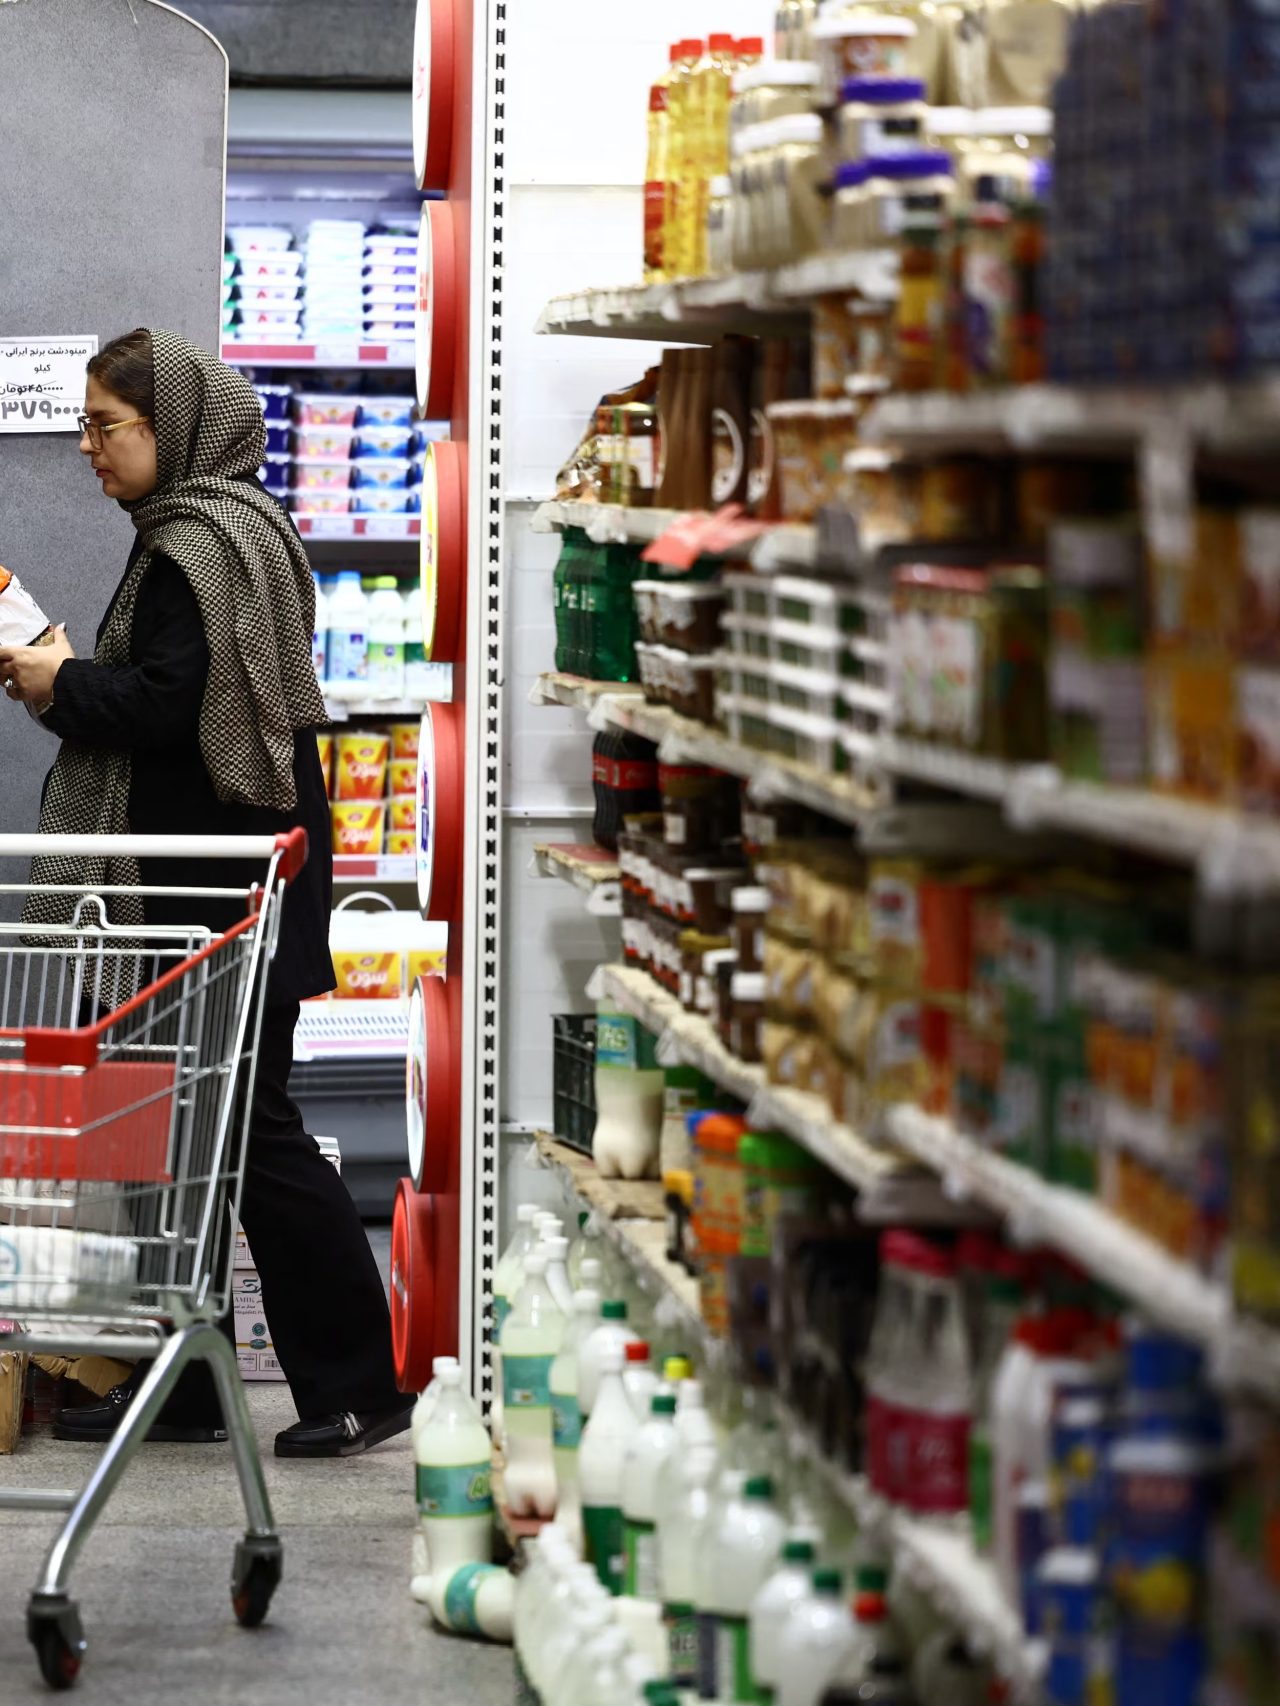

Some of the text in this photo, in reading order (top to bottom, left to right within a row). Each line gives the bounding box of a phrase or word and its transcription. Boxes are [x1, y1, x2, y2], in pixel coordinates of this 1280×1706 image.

[5, 346, 28, 357] ایرانی
[29, 347, 45, 357] برنج
[47, 346, 87, 357] مینودشت
[33, 364, 51, 374] کیلو
